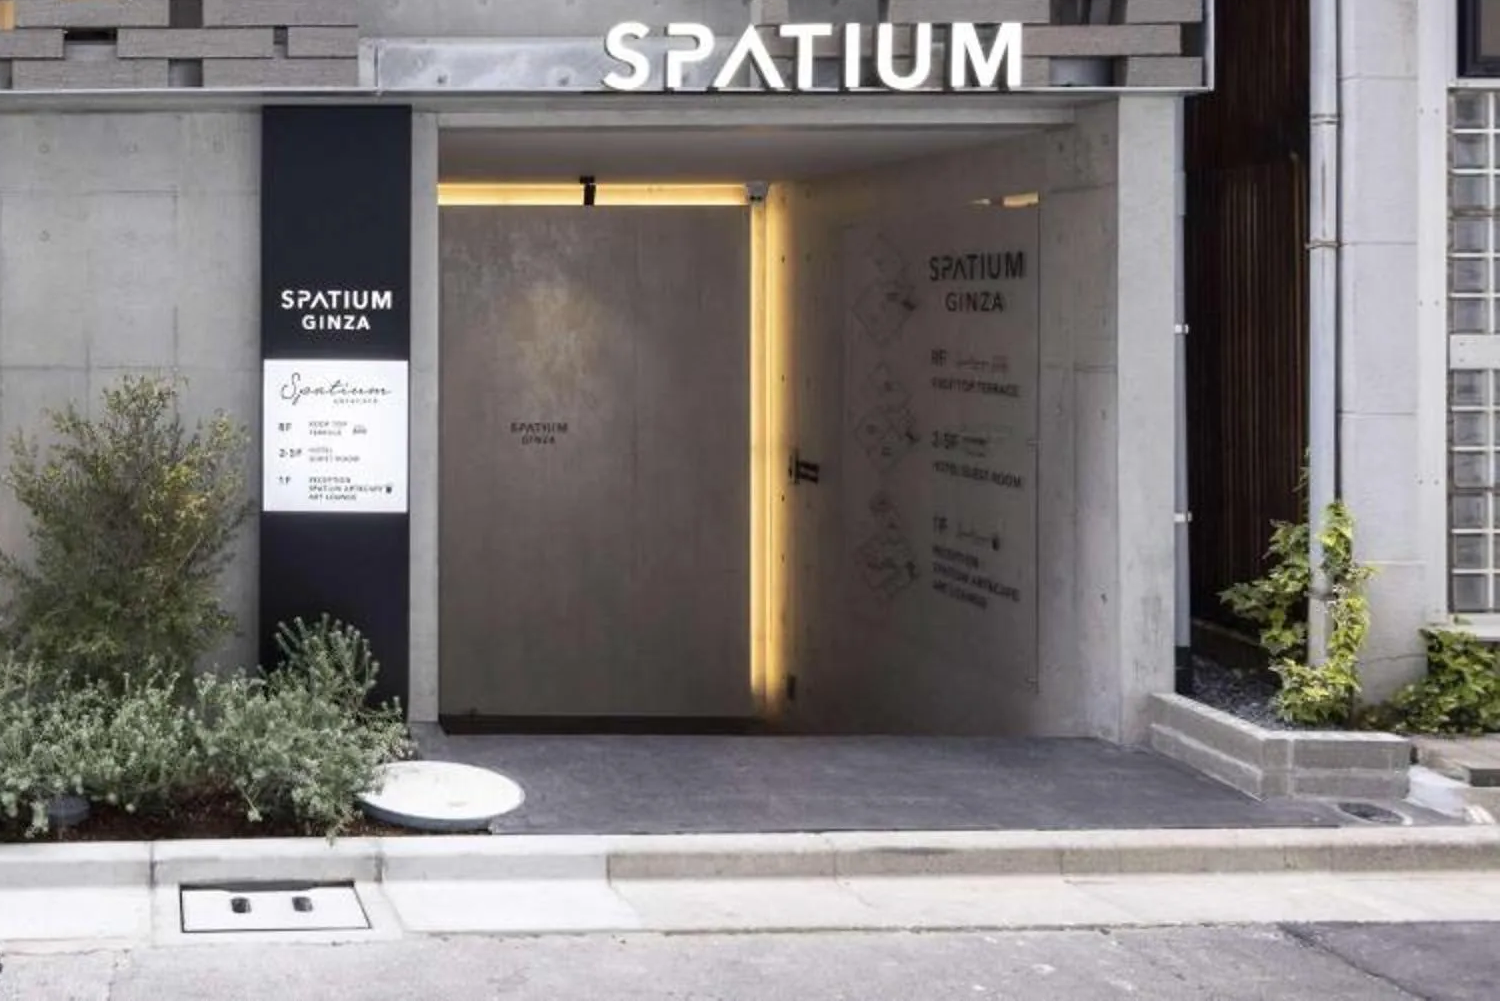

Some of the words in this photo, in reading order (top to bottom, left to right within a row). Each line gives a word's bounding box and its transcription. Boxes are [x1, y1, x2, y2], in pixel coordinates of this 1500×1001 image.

[602, 22, 1023, 91] SPATIUM
[929, 250, 1025, 282] SPATIUM
[281, 290, 393, 309] SPATIUM
[945, 291, 1005, 313] GINZA
[302, 315, 371, 330] GINZA
